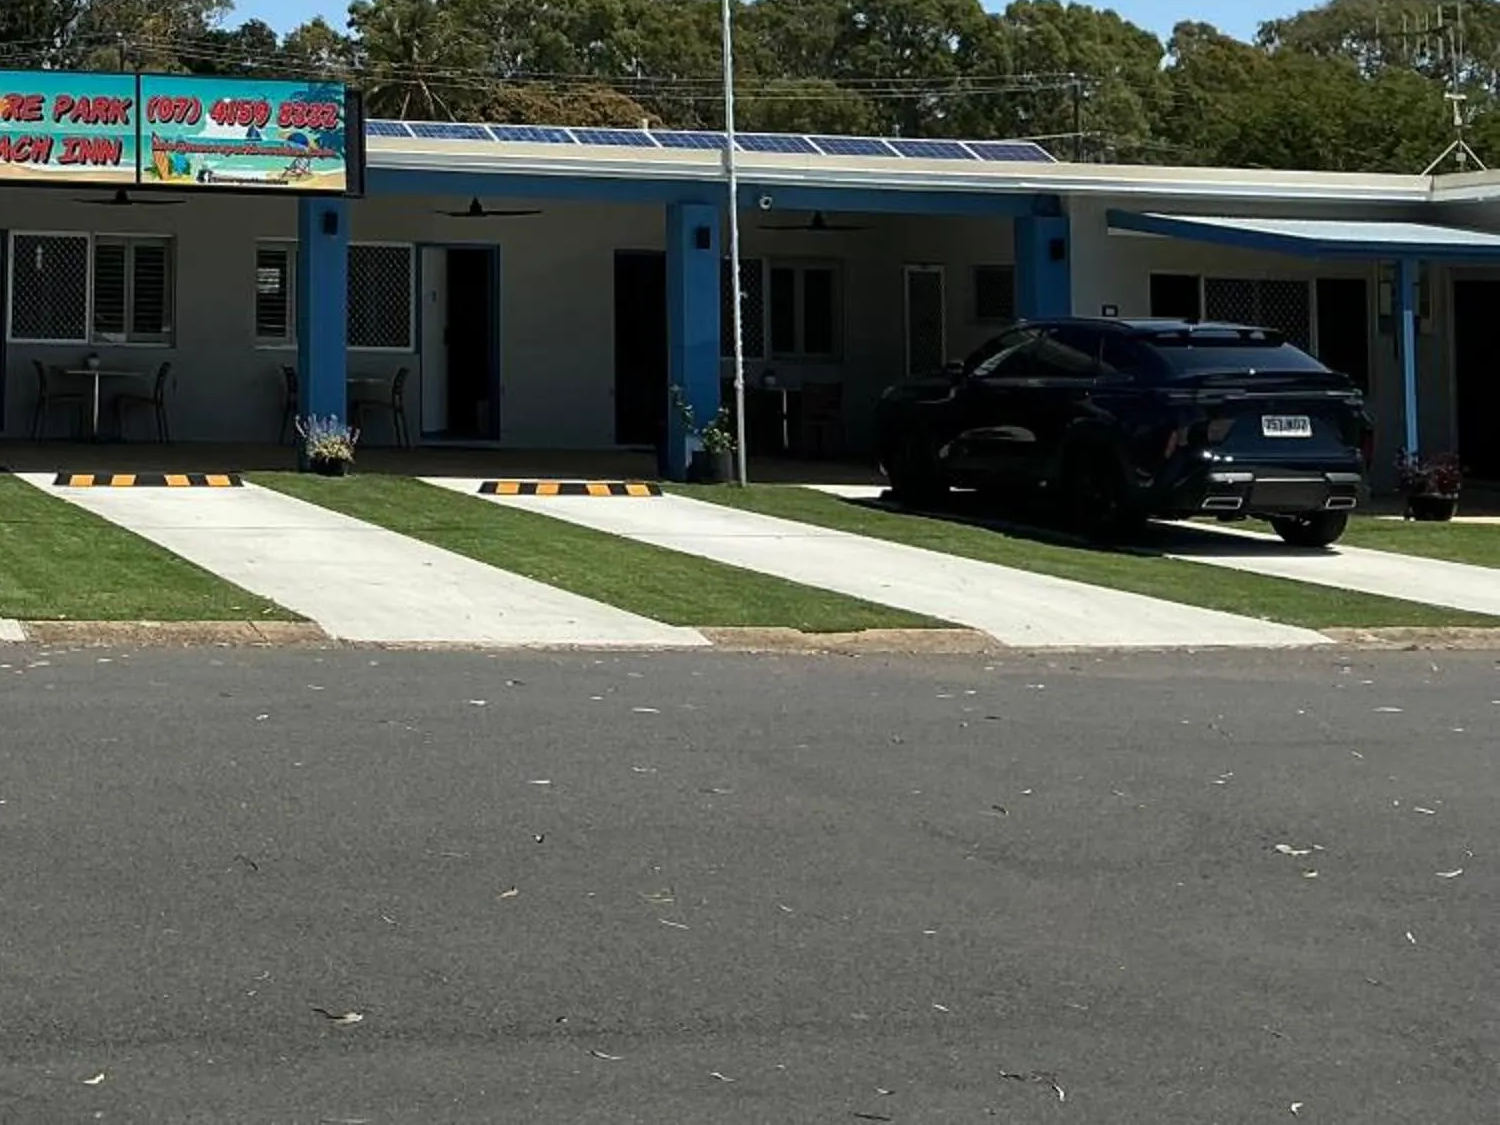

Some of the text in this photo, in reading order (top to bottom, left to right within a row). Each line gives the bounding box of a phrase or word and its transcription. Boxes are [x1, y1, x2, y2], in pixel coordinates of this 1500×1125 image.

[53, 94, 132, 125] PARK
[147, 96, 202, 125] (07)
[211, 98, 271, 127] 4159
[58, 136, 122, 165] INN
